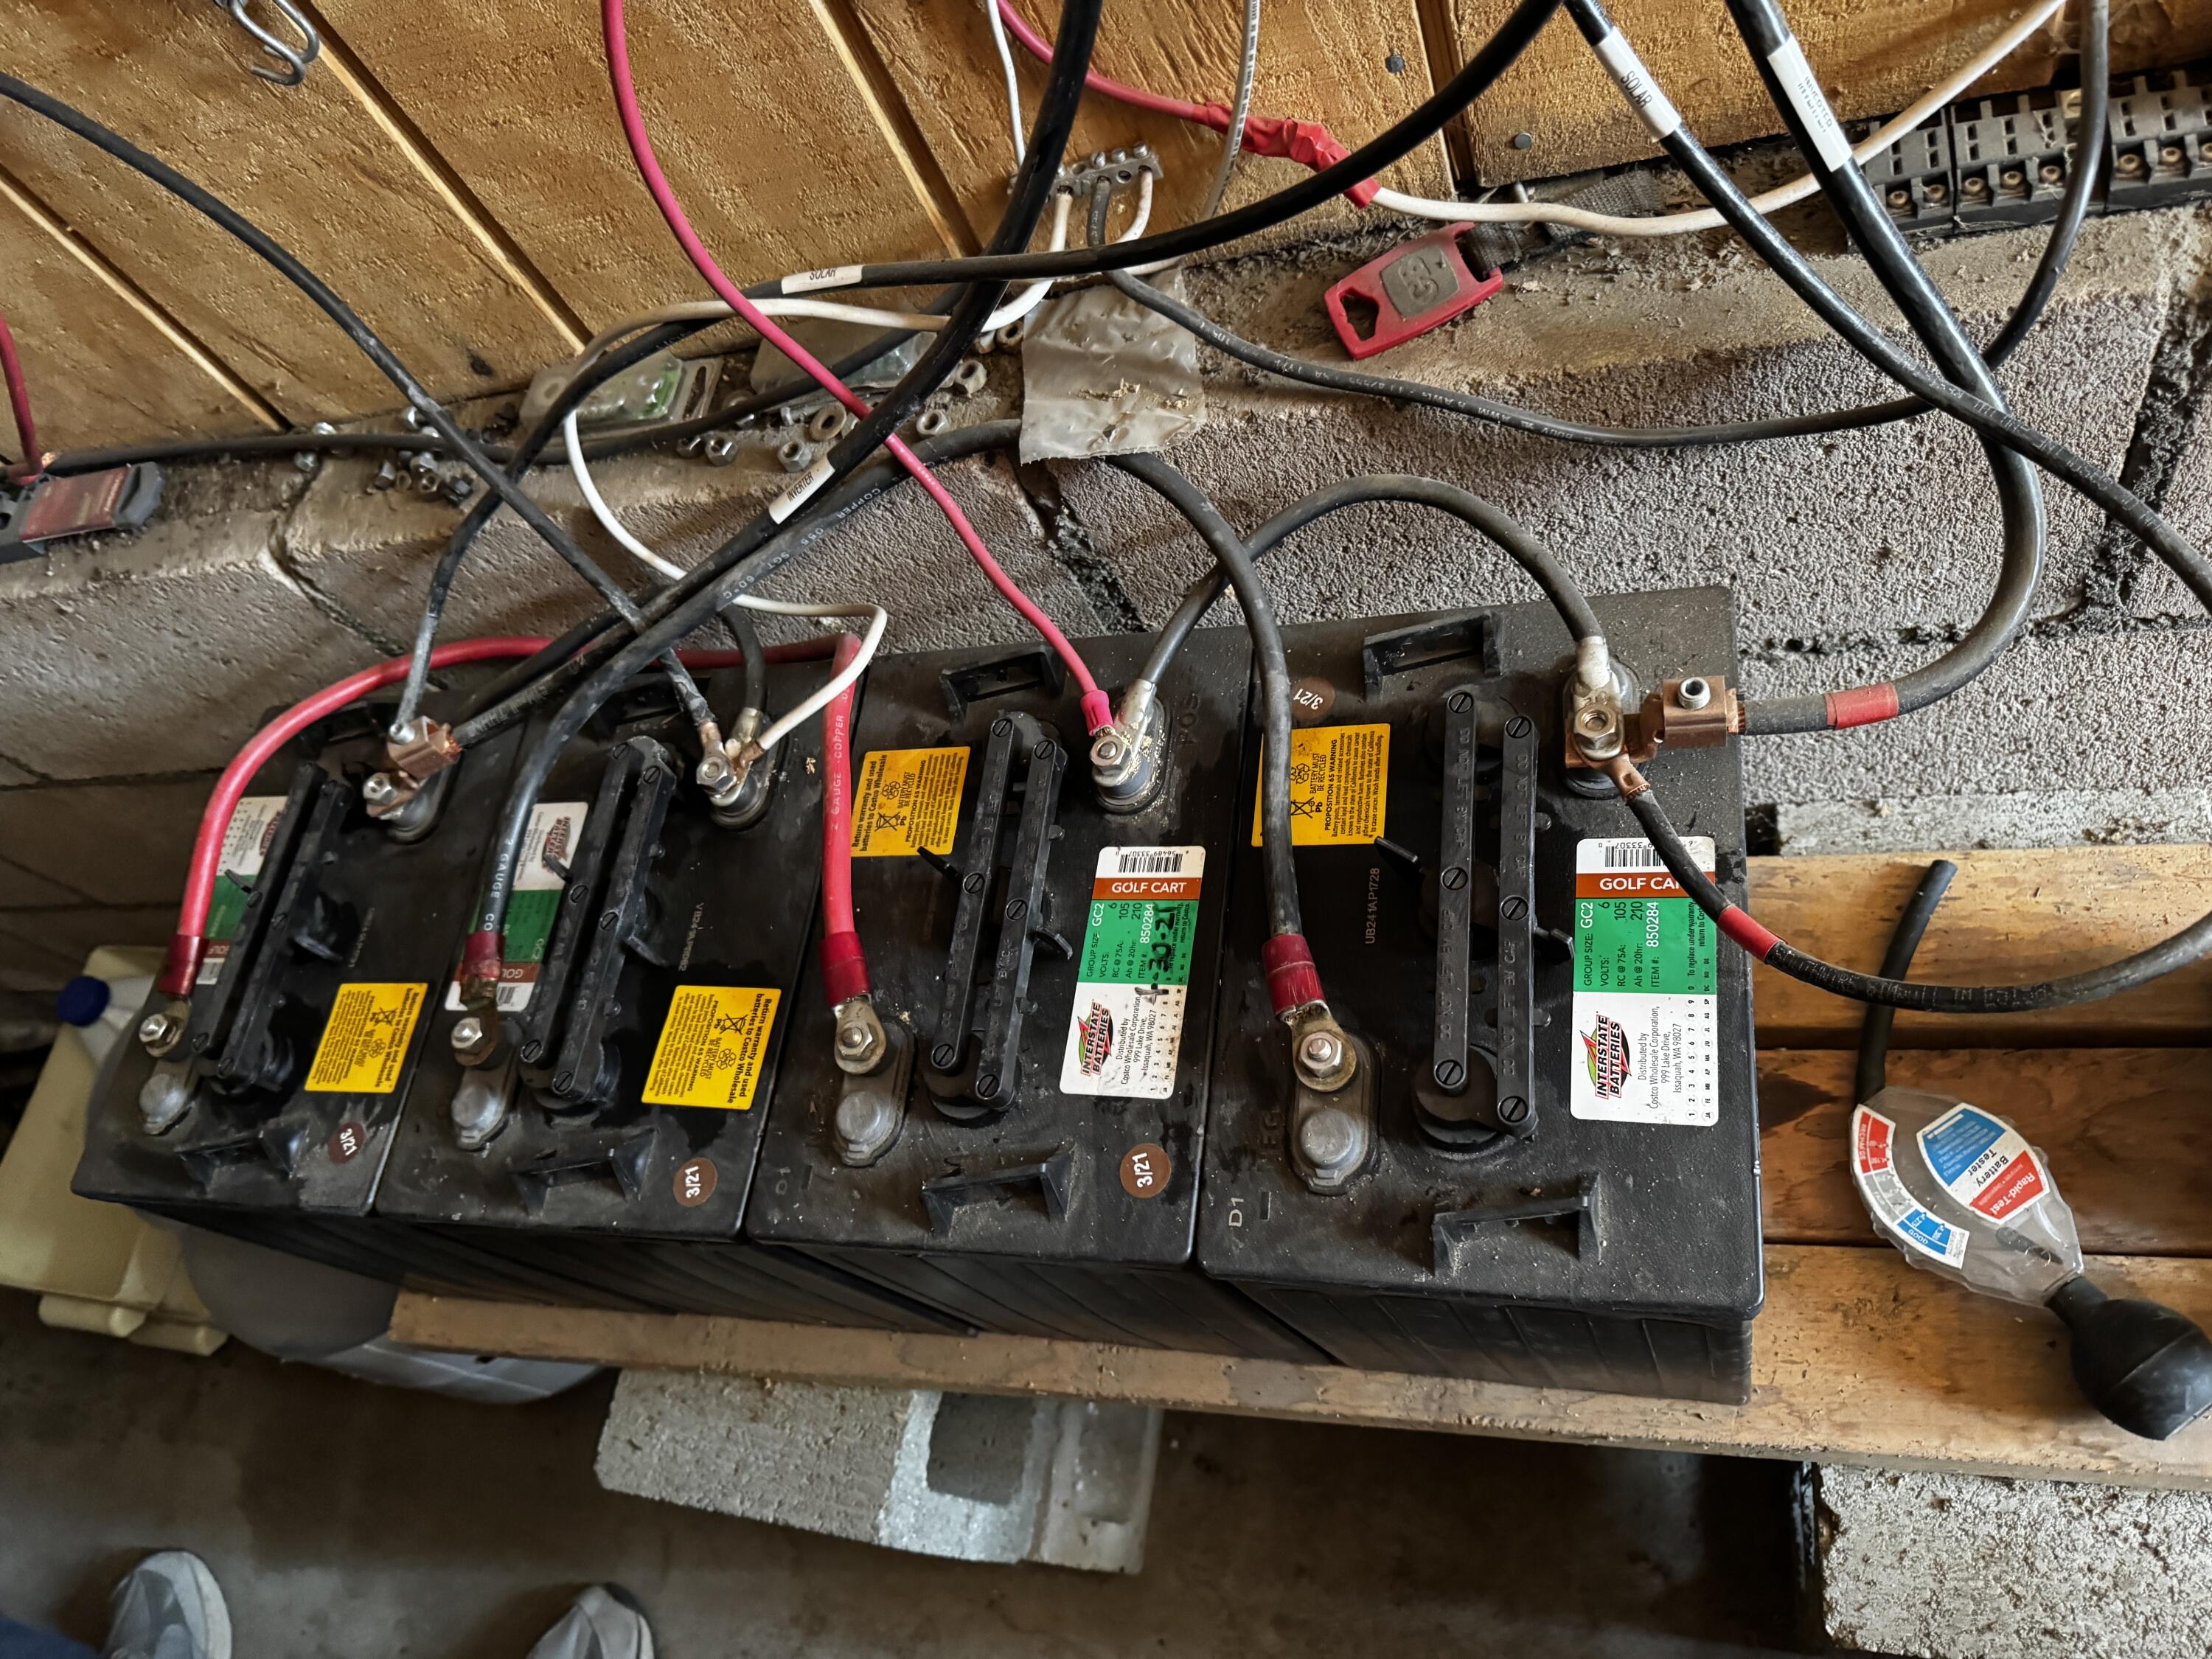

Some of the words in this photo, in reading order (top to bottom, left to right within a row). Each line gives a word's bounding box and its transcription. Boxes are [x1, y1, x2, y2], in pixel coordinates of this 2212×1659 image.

[1620, 71, 1652, 108] SOLAR
[1798, 76, 1833, 133] INVERTER
[809, 268, 837, 280] SOLAR
[787, 472, 815, 502] INVERTER
[838, 487, 882, 519] COPPER
[1293, 689, 1324, 709] 3/21
[834, 715, 844, 759] COPPER
[1329, 739, 1337, 771] WARNING
[867, 761, 877, 776] used
[873, 754, 887, 788] Wholesale
[1318, 754, 1326, 782] RECYCLED
[1327, 773, 1334, 782] 65
[865, 778, 873, 790] and
[1310, 769, 1318, 793] BATTERY
[831, 773, 842, 815] GAUGE
[858, 792, 871, 821] warranty
[868, 790, 879, 811] Costco
[1315, 801, 1322, 813] Pb
[1324, 784, 1333, 830] PROPOSITION
[852, 824, 861, 846] Return
[860, 821, 872, 851] batteries
[490, 853, 509, 900] GAUGE
[1112, 881, 1148, 894] GOLF
[1150, 881, 1187, 894] CART
[1599, 877, 1646, 891] GOLF
[1650, 877, 1681, 890] CA
[1091, 902, 1105, 926] GC2
[1139, 902, 1155, 943] 850284
[1580, 902, 1593, 928] GC2
[1614, 901, 1626, 920] 105
[1631, 901, 1644, 920] 210
[1646, 901, 1659, 947] 850284
[532, 939, 545, 961] GC2
[1112, 967, 1119, 977] RC
[1118, 902, 1130, 919] 105
[1124, 967, 1133, 977] Ah
[1130, 902, 1142, 919] 210
[1503, 940, 1515, 964] CAP
[1584, 933, 1593, 953] SIZE:
[1086, 949, 1097, 977] GROUP
[1617, 944, 1626, 963] 75A:
[1634, 942, 1643, 964] 20hr:
[1650, 956, 1660, 967] #:
[1687, 947, 1697, 967] replace
[501, 968, 525, 979] GOL
[1138, 961, 1147, 978] ITEM
[1503, 971, 1515, 988] BY
[1584, 955, 1593, 986] GROUP
[1599, 956, 1609, 986] VOLTS:
[1617, 975, 1625, 986] RC
[1634, 965, 1643, 973] @
[1634, 975, 1642, 987] Ah
[1650, 969, 1659, 987] ITEM
[748, 993, 764, 1026] batteries
[758, 998, 771, 1023] Return
[1147, 1009, 1156, 1029] 98027
[1503, 994, 1515, 1019] LIFT
[700, 1000, 718, 1046] PROPOSITION
[713, 1018, 722, 1029] Pb
[1137, 1016, 1148, 1033] Drive,
[1145, 1029, 1153, 1040] WA
[1649, 1006, 1660, 1048] Corporation,
[1672, 1023, 1682, 1046] 98027
[709, 1037, 722, 1062] BATTERY
[738, 1037, 751, 1061] Costco
[747, 1026, 764, 1060] warranty
[1081, 1004, 1101, 1074] INTERSTATE
[1092, 1008, 1110, 1072] BATTERIES
[1116, 1023, 1128, 1060] Distributed
[1124, 1032, 1135, 1063] Wholesale
[1134, 1034, 1144, 1048] Lake
[1501, 1026, 1515, 1051] NOT
[1660, 1031, 1672, 1050] Drive,
[699, 1047, 712, 1077] RECYCLED
[1133, 1049, 1142, 1062] 999
[1141, 1042, 1153, 1071] Issaquah,
[1596, 1016, 1608, 1096] INTERSTATE
[1609, 1021, 1620, 1095] BATTERIES
[1638, 1039, 1647, 1080] Distributed
[1660, 1051, 1670, 1068] Lake
[1673, 1046, 1681, 1059] WA
[686, 1057, 701, 1091] WARNING
[704, 1062, 714, 1079] MUST
[744, 1062, 754, 1076] and
[1121, 1064, 1131, 1085] Costco
[1502, 1058, 1515, 1077] DO
[1649, 1049, 1659, 1085] Wholesale
[1660, 1068, 1670, 1083] 999
[1672, 1060, 1683, 1093] Issaquah,
[726, 1063, 745, 1103] Wholesale
[738, 1078, 750, 1096] used
[1649, 1085, 1659, 1108] Costco
[340, 1128, 357, 1156] 3/21
[1858, 1124, 1867, 1161] RECHARGE
[1136, 1152, 1152, 1188] 3/21
[1969, 1149, 1997, 1176] Tester
[1976, 1155, 2009, 1188] Battery
[686, 1166, 700, 1198] 3/21
[1989, 1172, 2036, 1215] Rapid-Test
[1229, 1197, 1244, 1227] D1
[1907, 1228, 1929, 1245] GOOD
